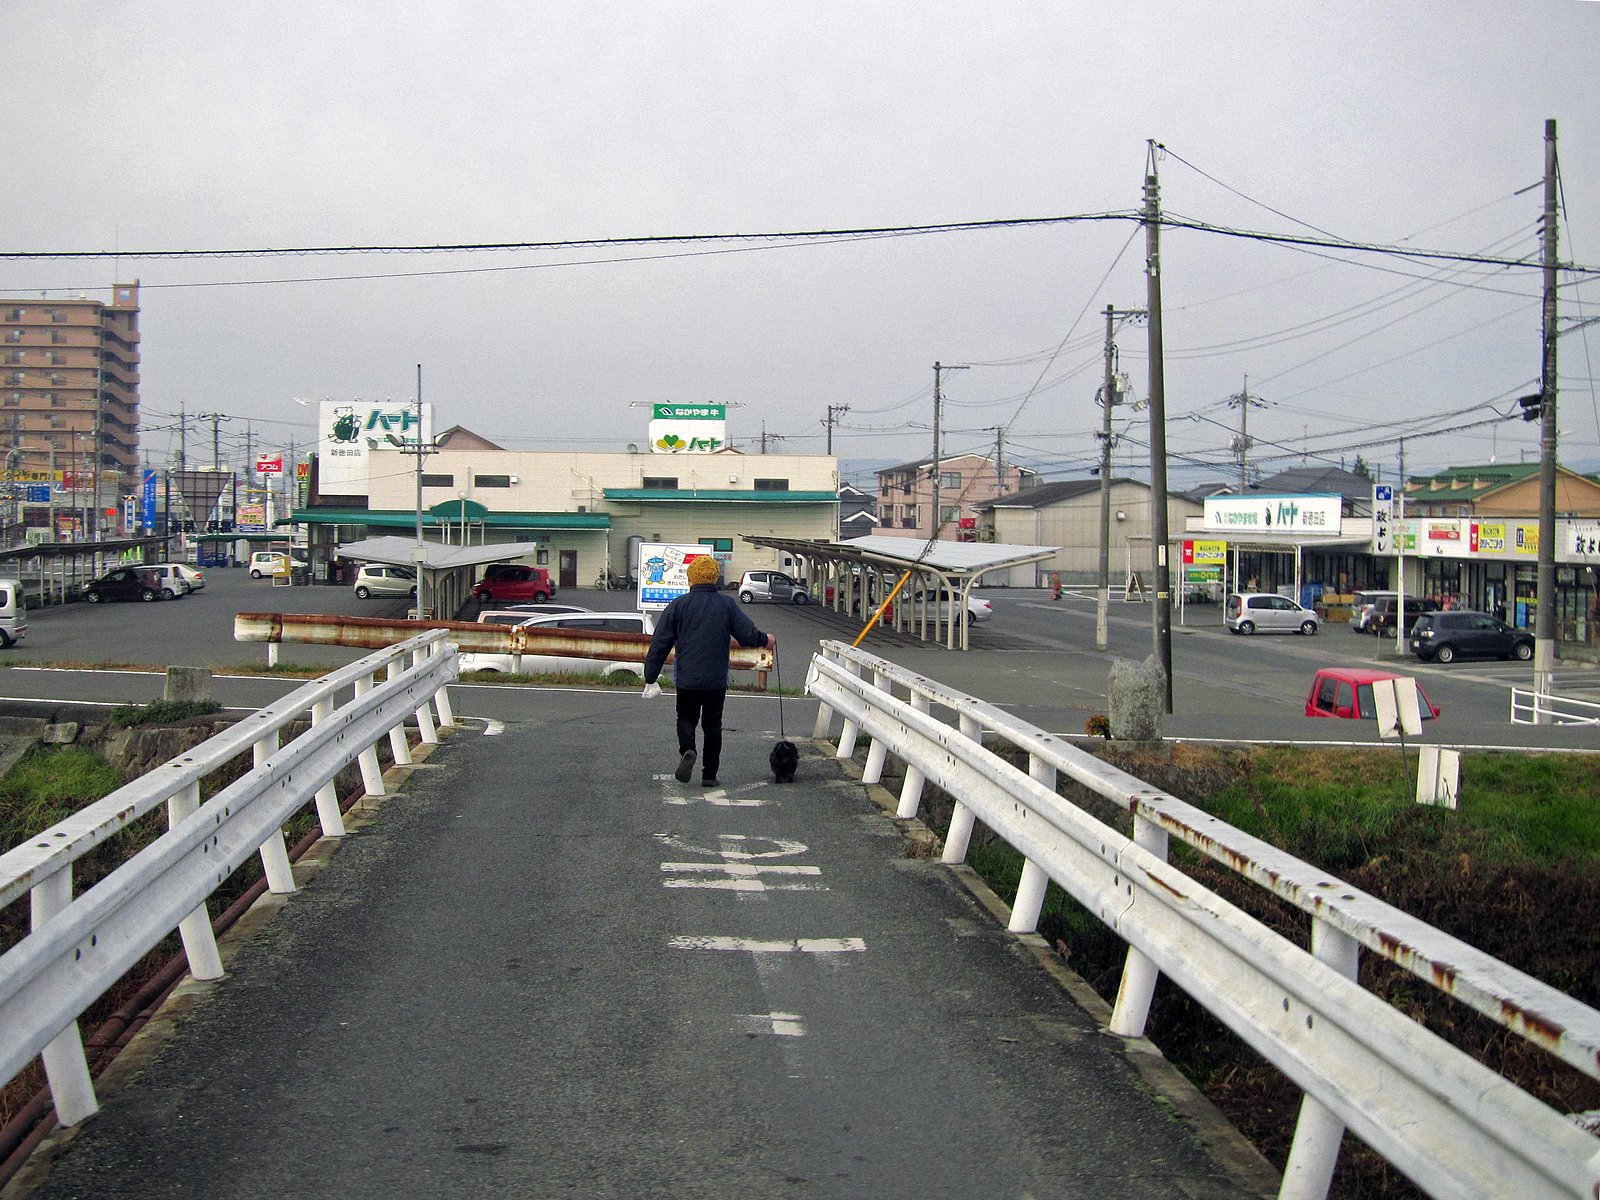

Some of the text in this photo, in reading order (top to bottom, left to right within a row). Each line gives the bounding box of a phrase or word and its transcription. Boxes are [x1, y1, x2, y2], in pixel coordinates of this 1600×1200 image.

[364, 408, 418, 433] ハート
[687, 436, 723, 452] ハート
[259, 462, 279, 471] アコム
[1275, 500, 1299, 527] ハート
